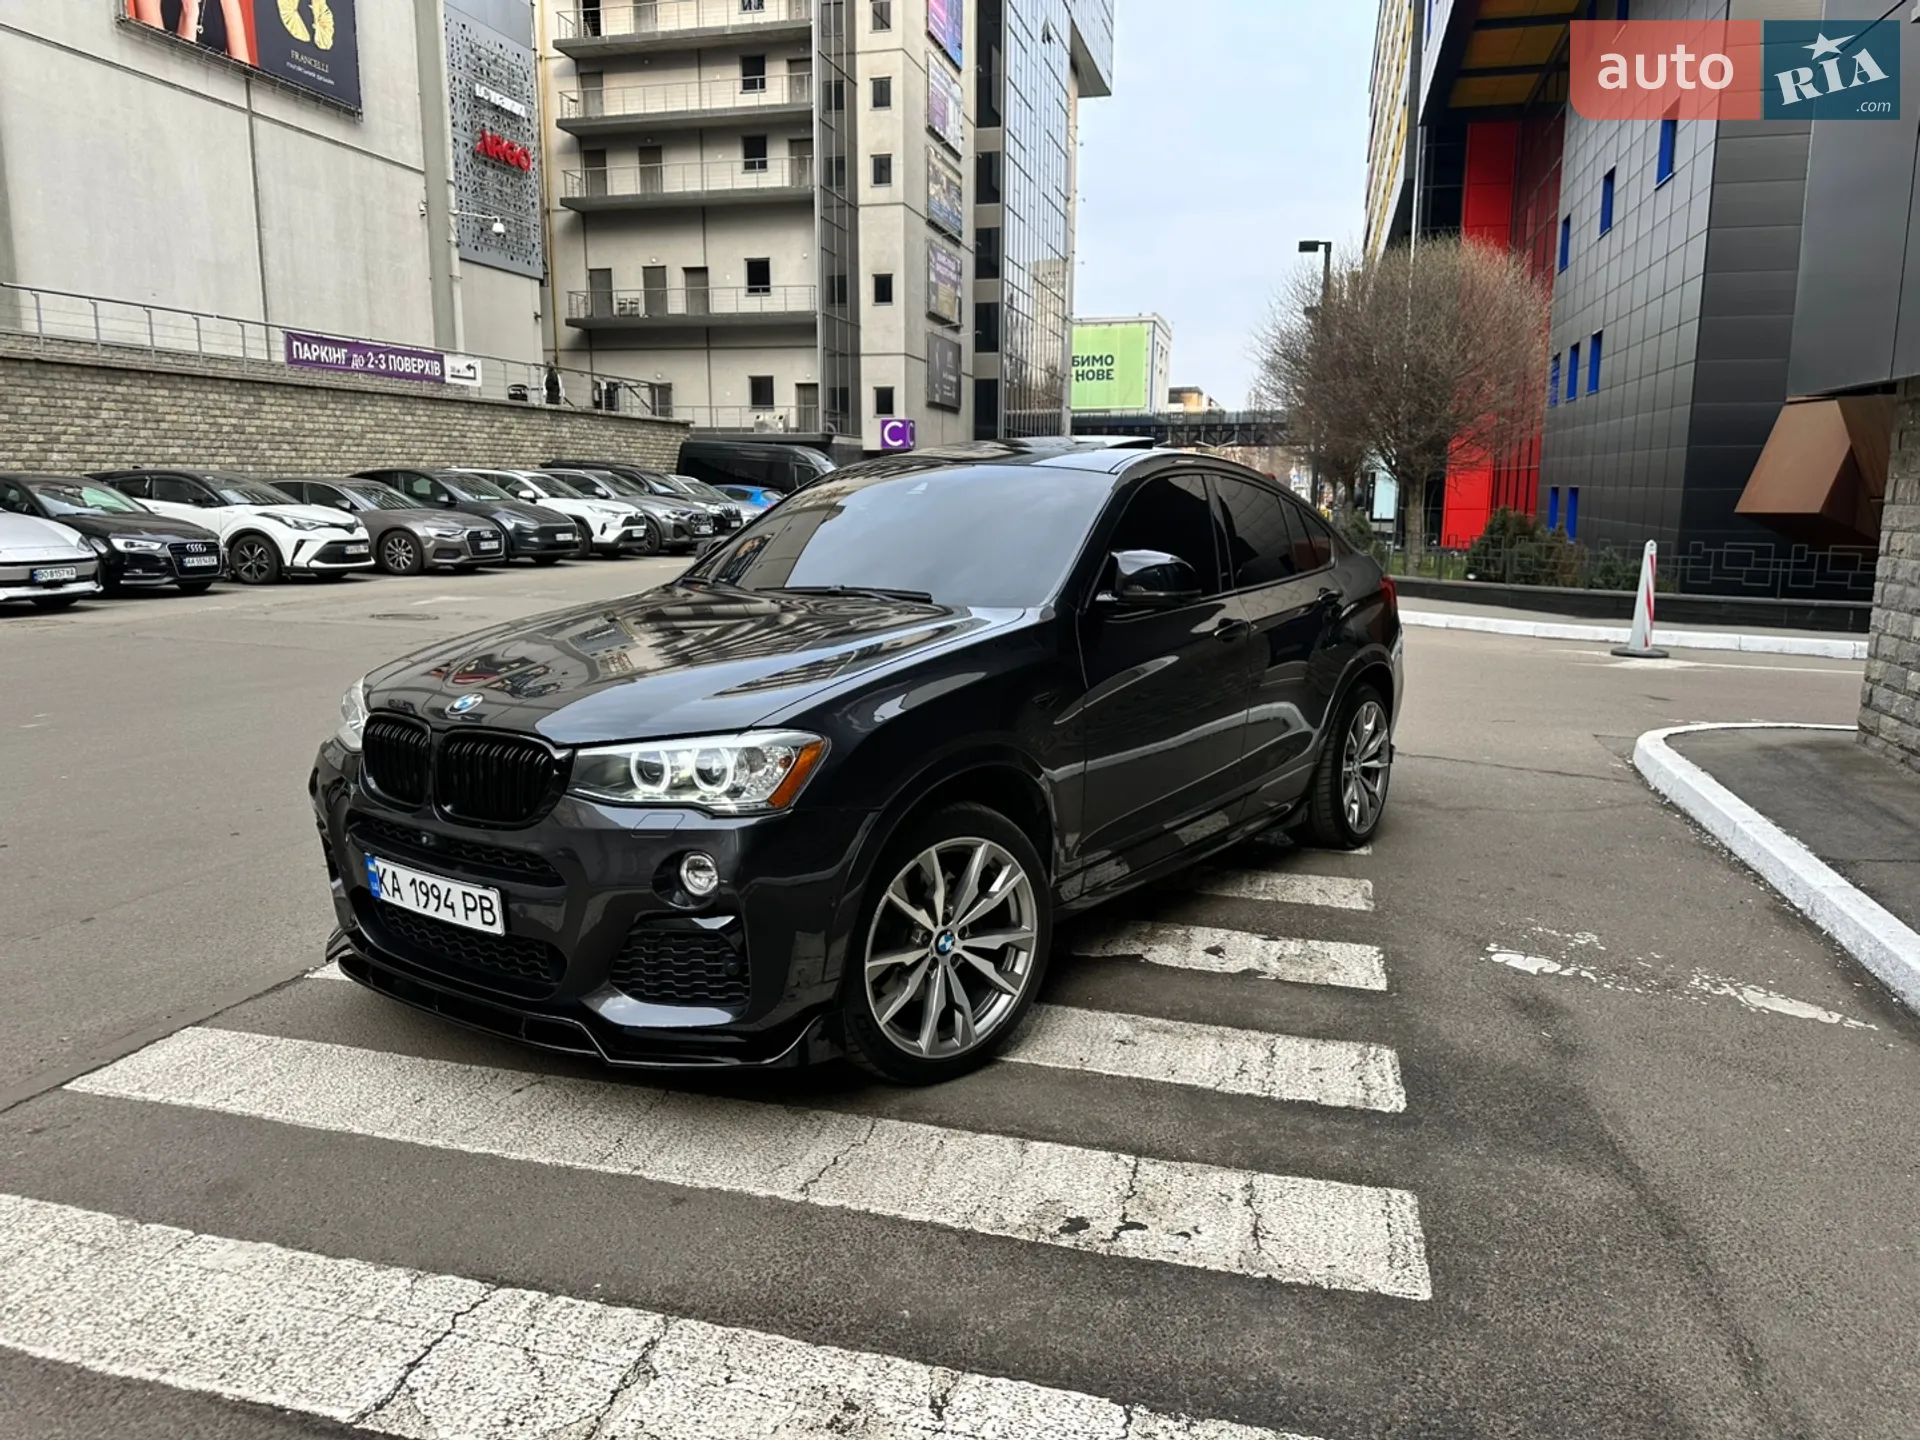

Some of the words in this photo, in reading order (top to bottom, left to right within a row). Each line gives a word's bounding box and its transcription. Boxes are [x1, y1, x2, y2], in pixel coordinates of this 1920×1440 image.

[475, 127, 532, 172] ARGO
[292, 341, 348, 365] ПАРКІНГ
[367, 352, 386, 370] 2-3
[388, 354, 441, 376] ПОВЕРХІВ
[883, 421, 903, 446] C
[376, 865, 404, 902] KA
[409, 877, 456, 918] 1994
[461, 890, 497, 927] PB
